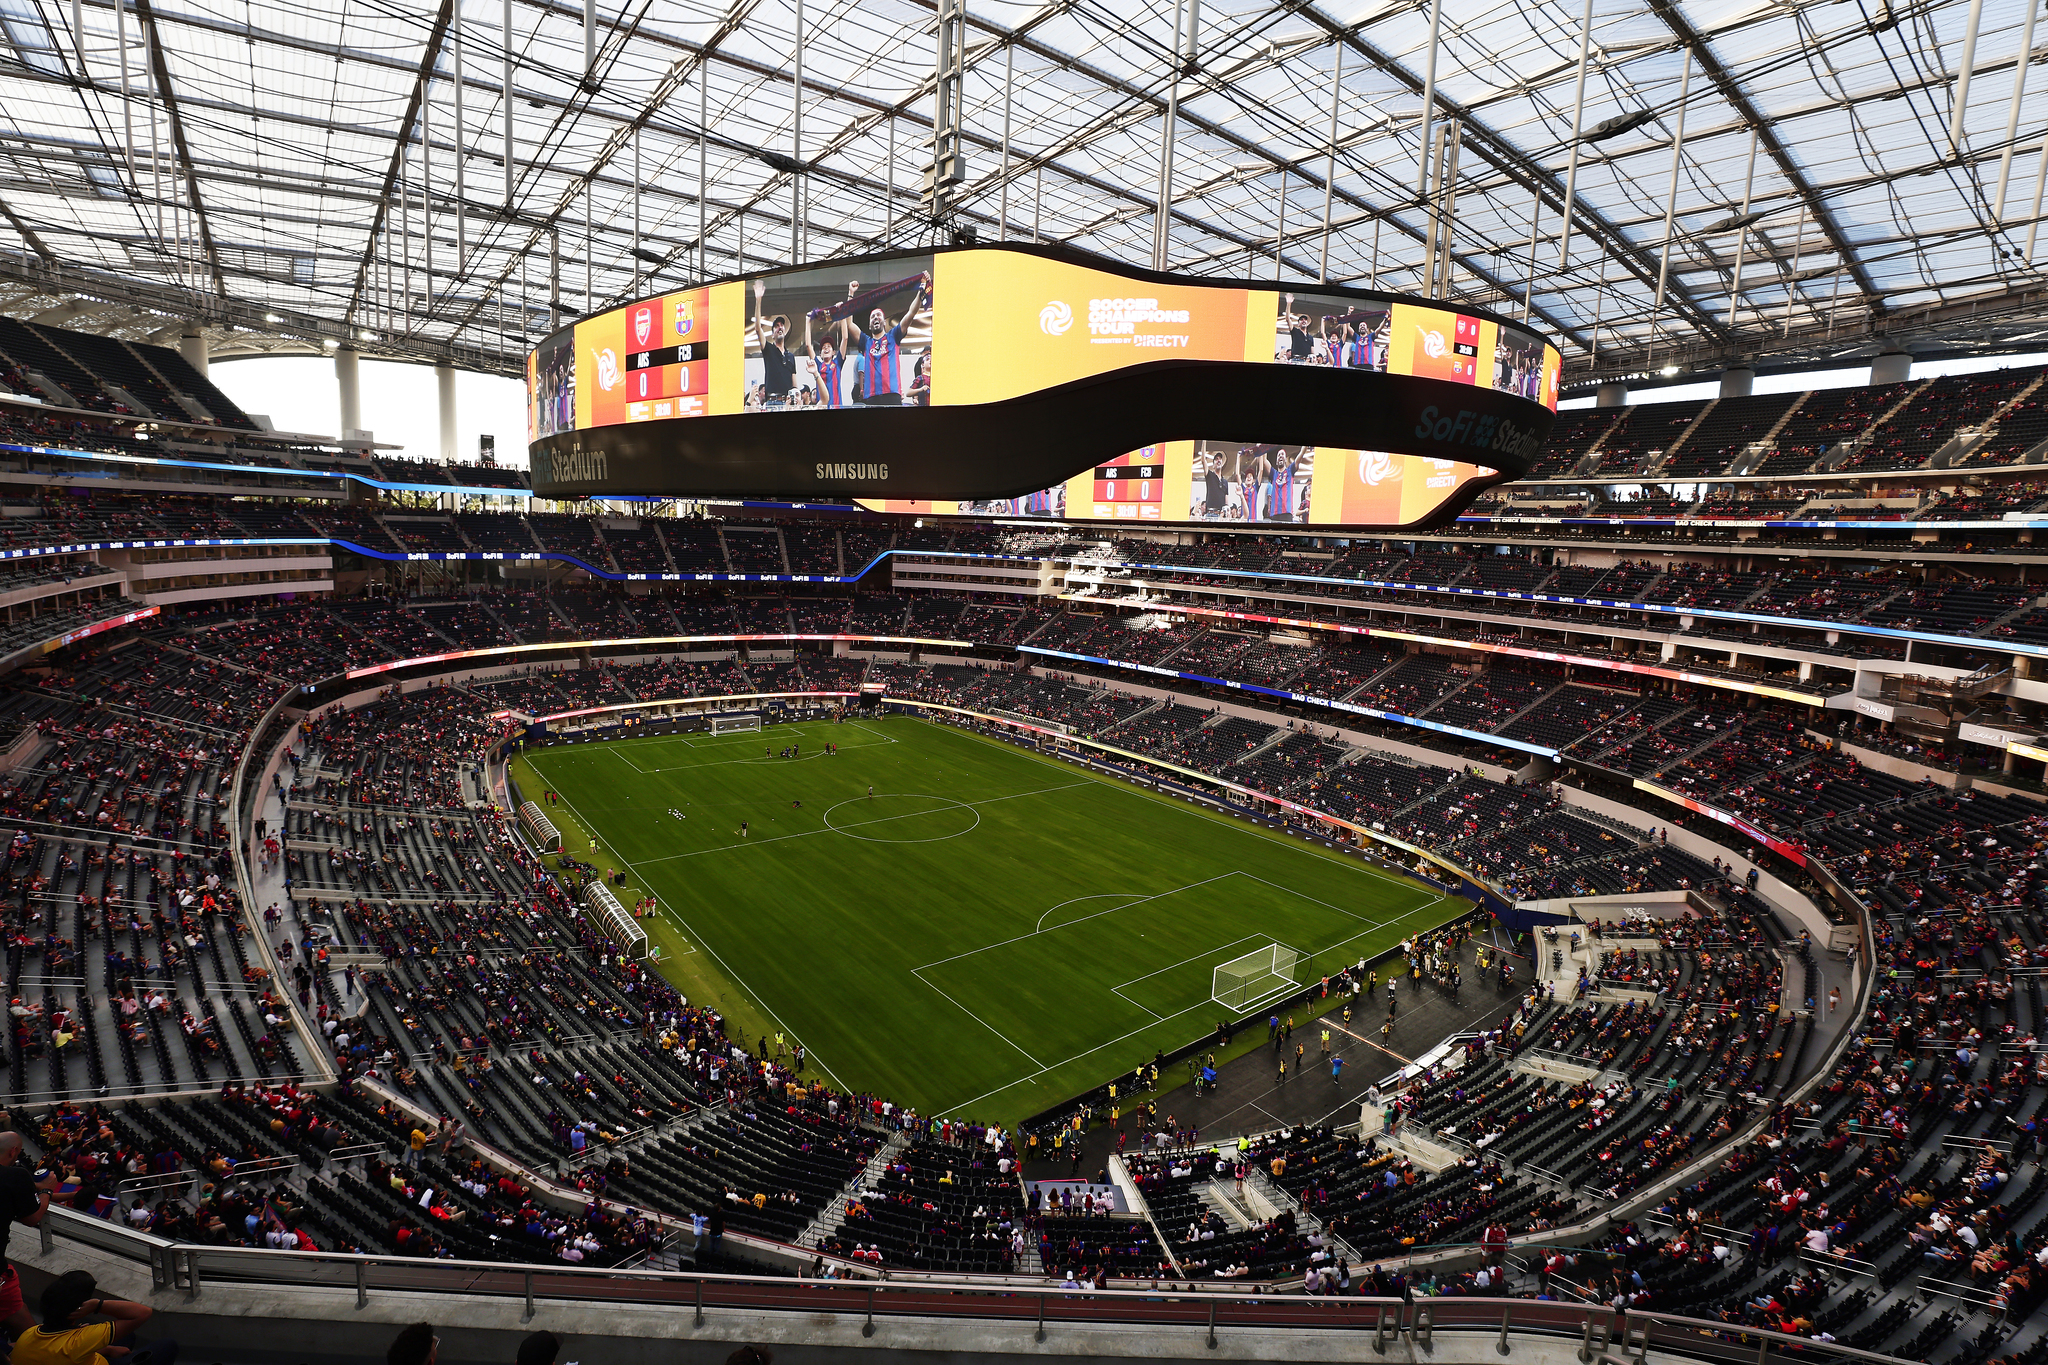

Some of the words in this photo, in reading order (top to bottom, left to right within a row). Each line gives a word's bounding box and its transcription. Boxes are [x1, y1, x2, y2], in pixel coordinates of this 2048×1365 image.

[1088, 298, 1158, 311] SOCCER
[1088, 310, 1190, 323] CHAMPIONS
[1088, 322, 1135, 335] TOUR
[1470, 324, 1476, 336] 0
[1133, 334, 1189, 347] DIRECTV
[637, 352, 650, 368] ARS
[678, 345, 692, 361] FCB
[1467, 364, 1473, 376] 0
[640, 372, 647, 397] 0
[680, 366, 689, 392] 0
[1415, 405, 1477, 444] SoFi
[551, 442, 608, 483] Stadium
[1434, 460, 1455, 470] TOUR
[816, 463, 889, 479] SAMSUNG
[1105, 468, 1118, 478] ARS
[1140, 467, 1152, 477] FCB
[1426, 475, 1457, 488] DIRECTV
[1106, 482, 1115, 500] 0
[1141, 481, 1150, 500] 0
[1116, 505, 1137, 518] 30:00
[1120, 661, 1137, 669] CHECK
[1307, 695, 1330, 707] CHECK
